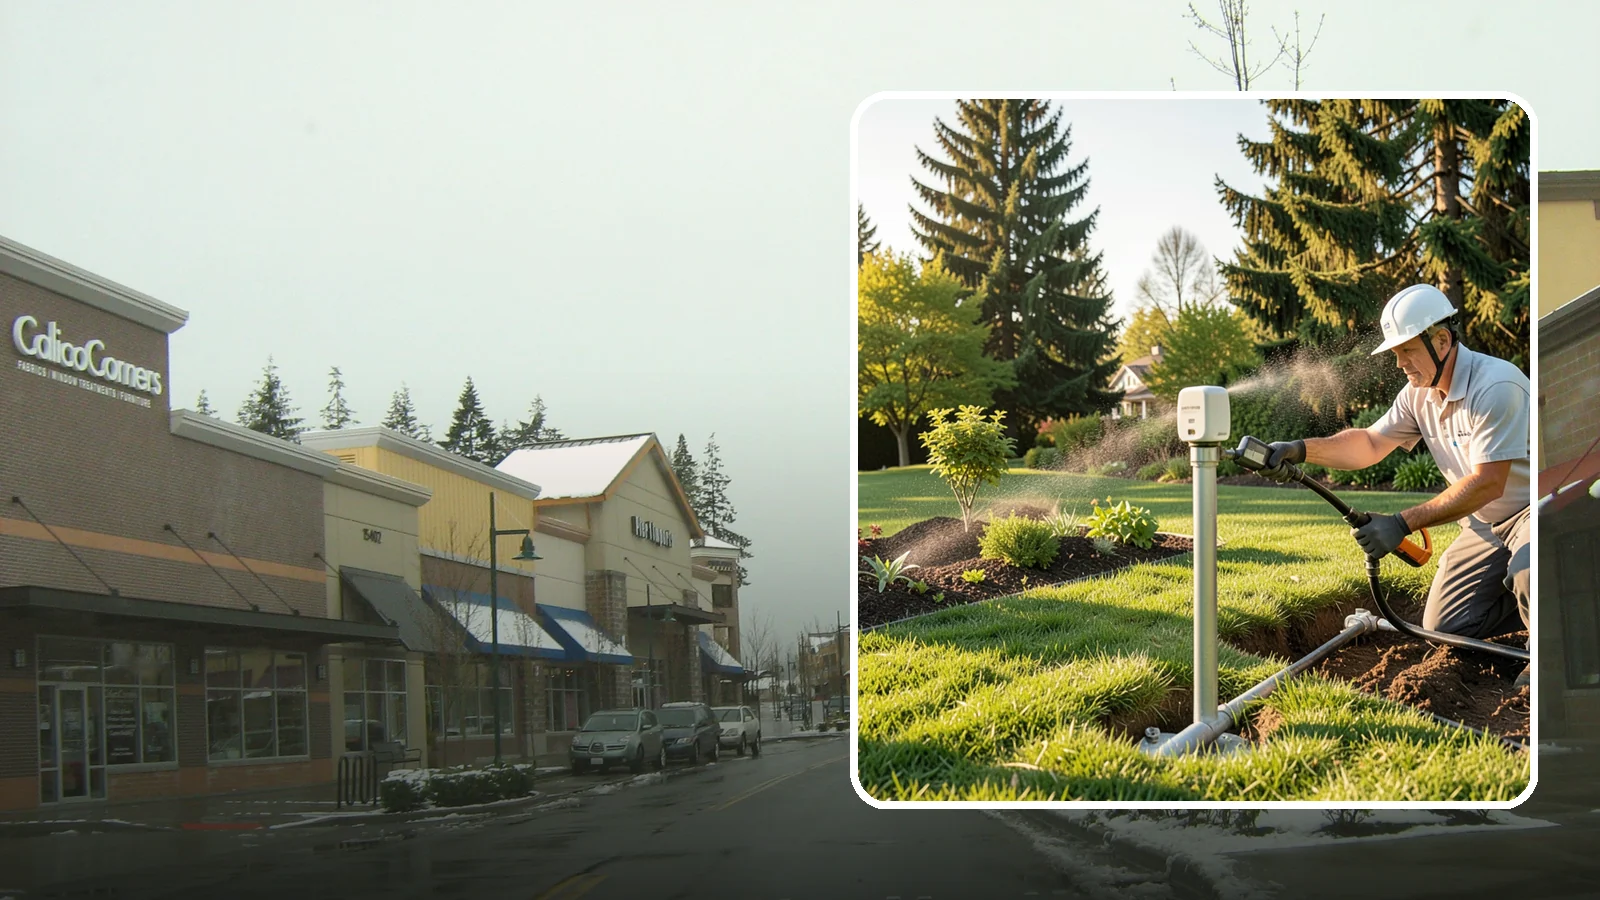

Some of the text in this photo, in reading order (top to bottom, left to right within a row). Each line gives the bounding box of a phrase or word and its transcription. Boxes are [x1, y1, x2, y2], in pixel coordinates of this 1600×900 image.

[17, 360, 151, 409] FABRICS WINDOW TREATMENTS FURNITURE
